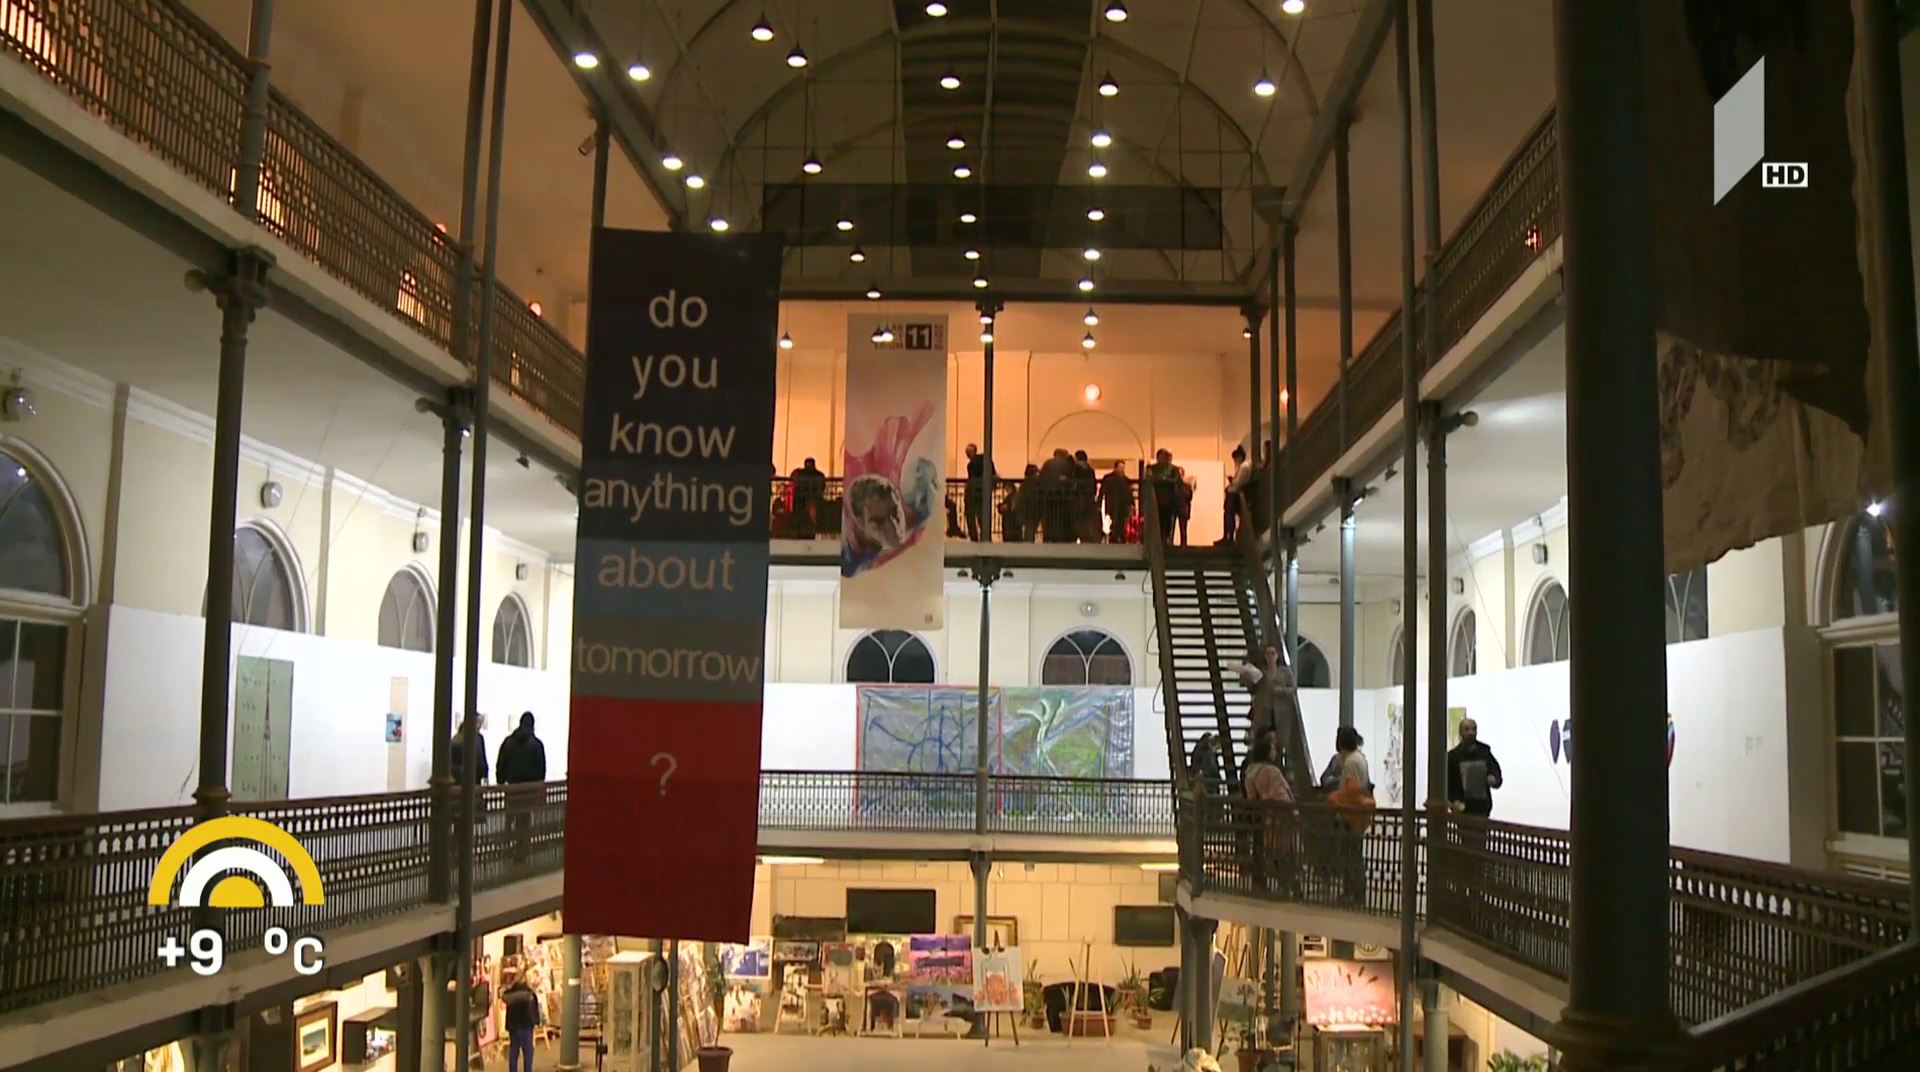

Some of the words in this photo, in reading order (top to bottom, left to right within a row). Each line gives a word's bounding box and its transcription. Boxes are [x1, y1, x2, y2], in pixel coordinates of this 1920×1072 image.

[649, 289, 708, 328] do
[907, 326, 931, 348] 11
[631, 354, 718, 400] you
[609, 413, 736, 459] know
[584, 471, 753, 526] anything
[598, 546, 736, 591] about
[575, 636, 760, 683] tomorrow
[650, 752, 678, 796] ?
